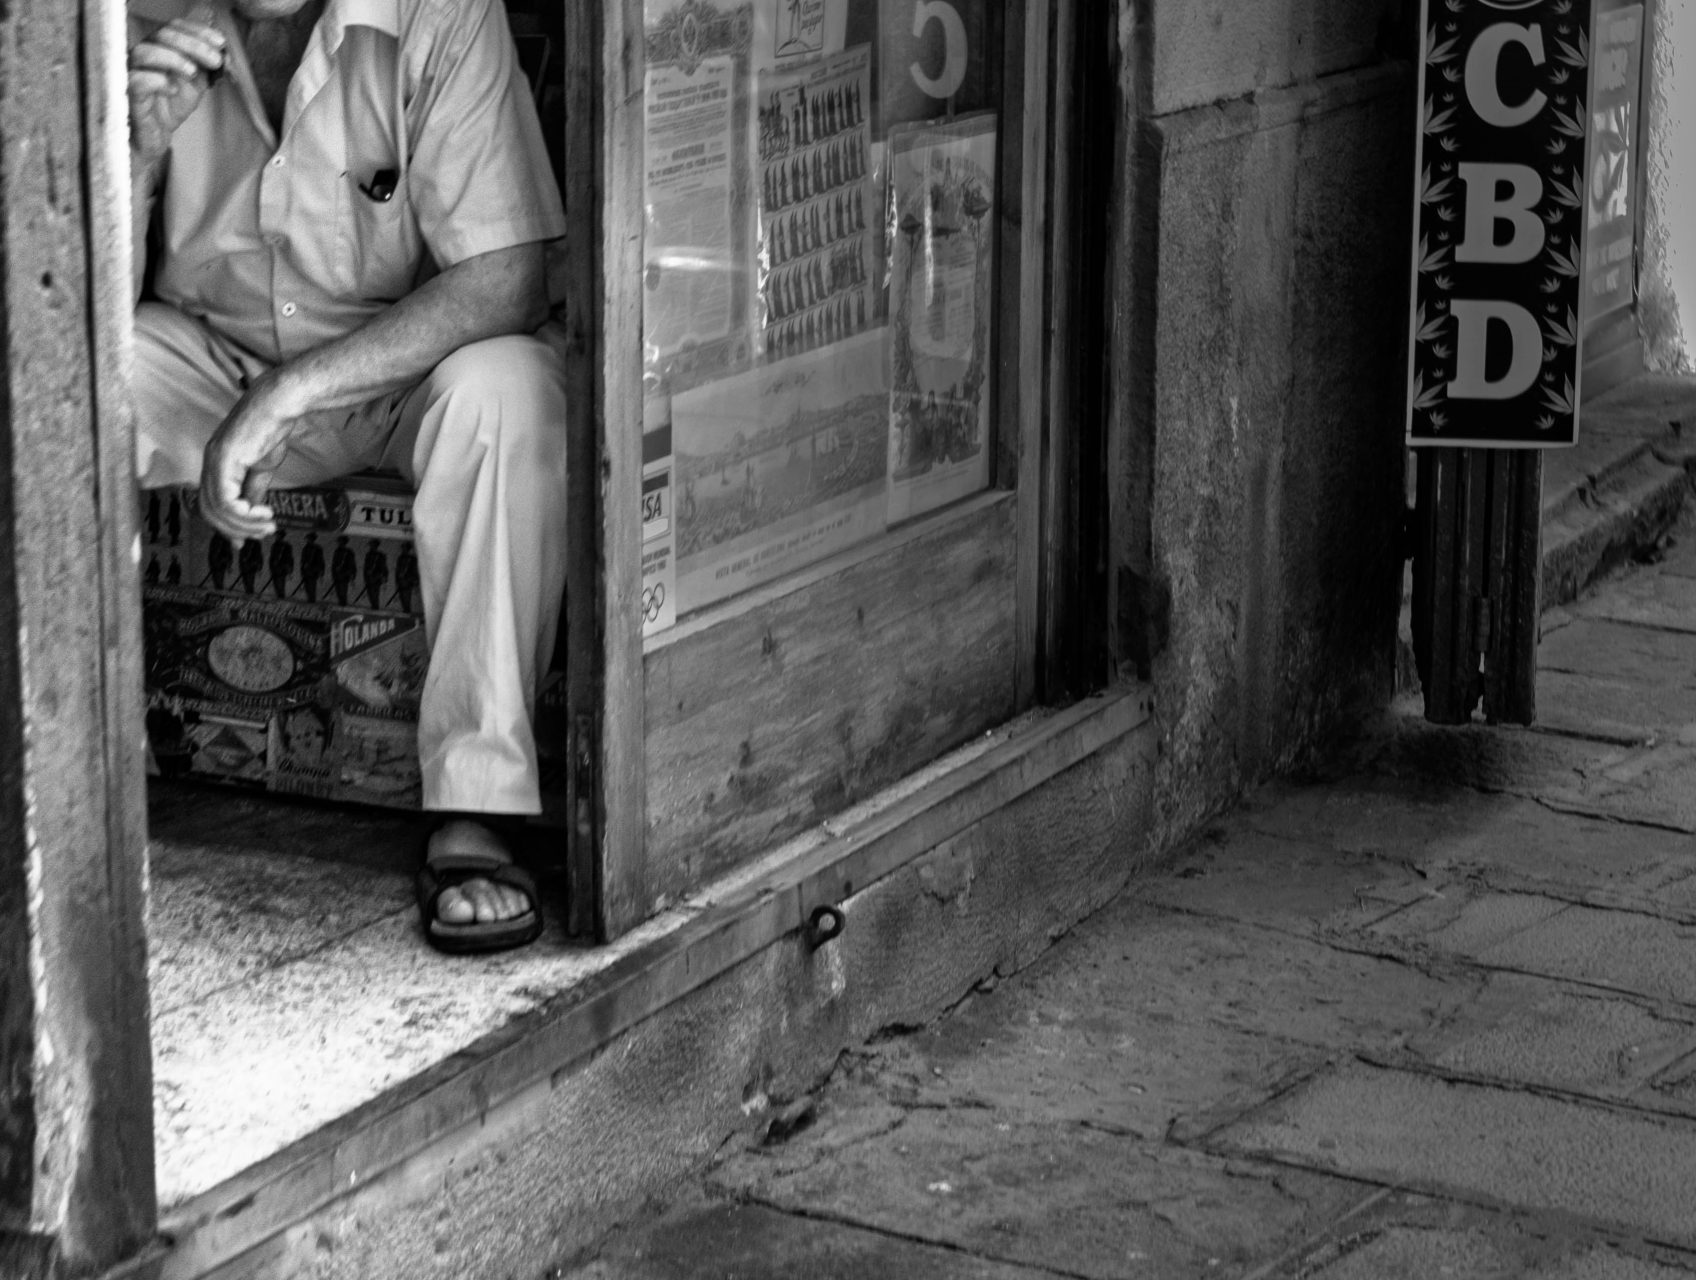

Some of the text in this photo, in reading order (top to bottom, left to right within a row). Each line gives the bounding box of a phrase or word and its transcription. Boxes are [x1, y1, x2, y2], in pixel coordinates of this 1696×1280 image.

[1447, 21, 1549, 400] CBD
[361, 506, 412, 526] TUL
[641, 492, 662, 523] ISA
[330, 614, 396, 659] HOLANDA
